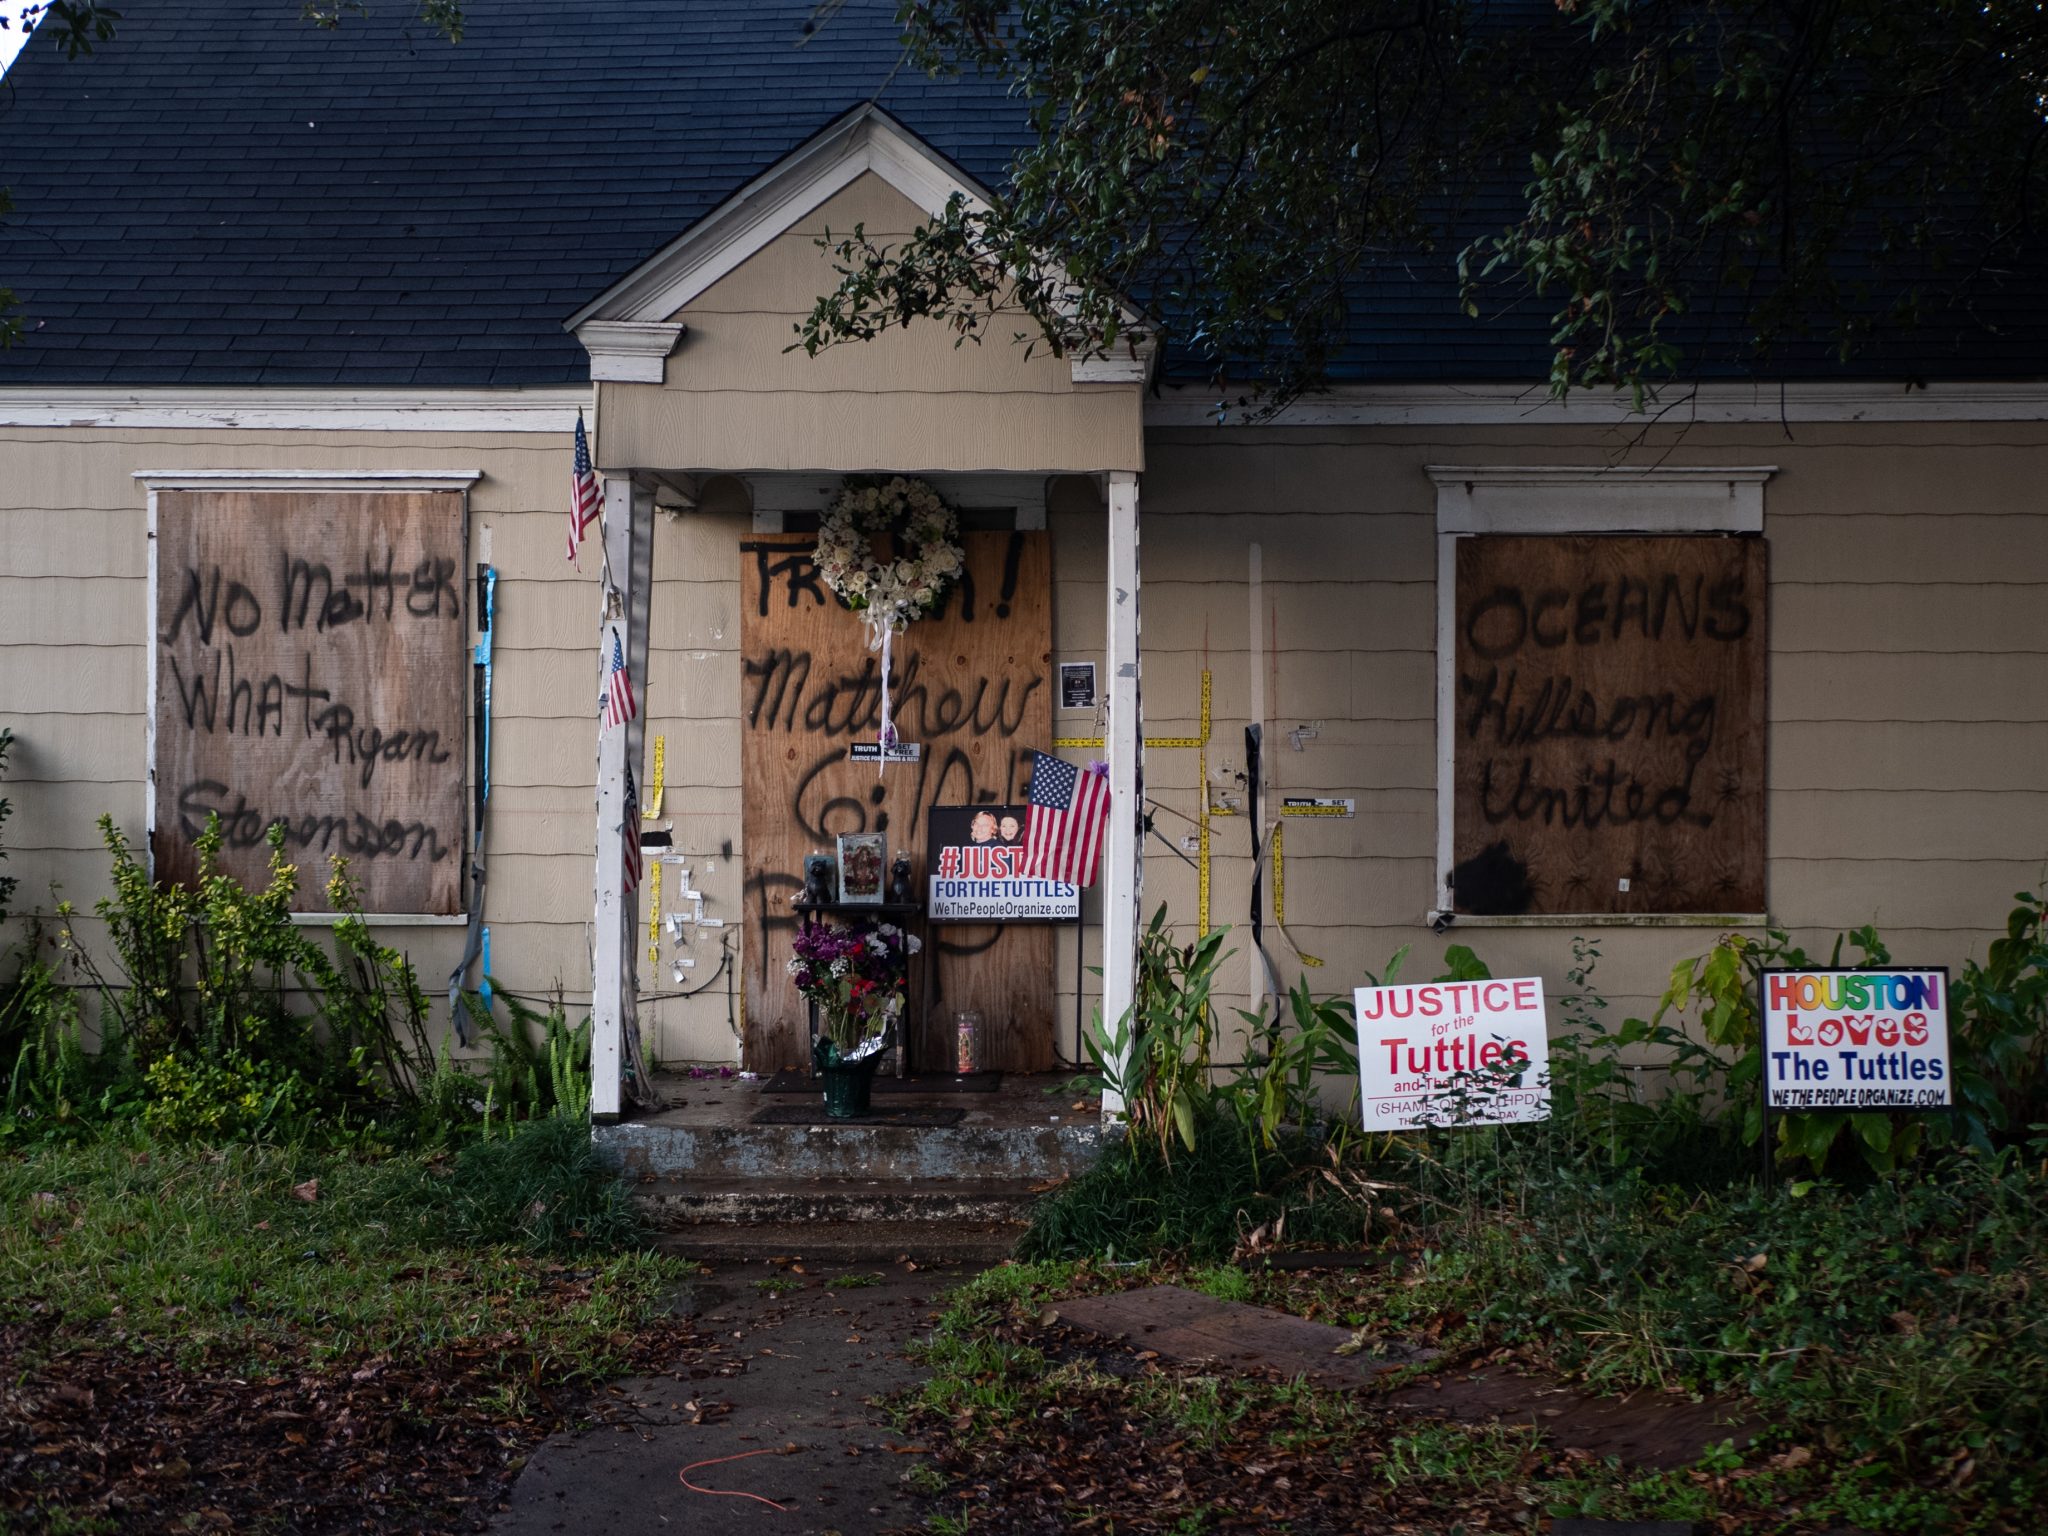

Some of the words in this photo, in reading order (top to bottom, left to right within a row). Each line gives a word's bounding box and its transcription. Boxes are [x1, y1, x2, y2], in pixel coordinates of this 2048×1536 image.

[743, 647, 1043, 739] Matthew
[935, 881, 1075, 898] FORTHETUTTLES
[934, 902, 1077, 918] WeThePeopleOrganize.com
[1364, 981, 1538, 1020] JUSTICE
[1770, 975, 1939, 1011] HOUSTON
[1431, 1021, 1450, 1037] for
[1454, 1015, 1474, 1030] the
[1381, 1033, 1529, 1075] Tuttles
[1772, 1051, 1829, 1081] The
[1839, 1051, 1943, 1081] Tuttles
[1394, 1078, 1420, 1093] and
[1499, 1110, 1519, 1119] DAY
